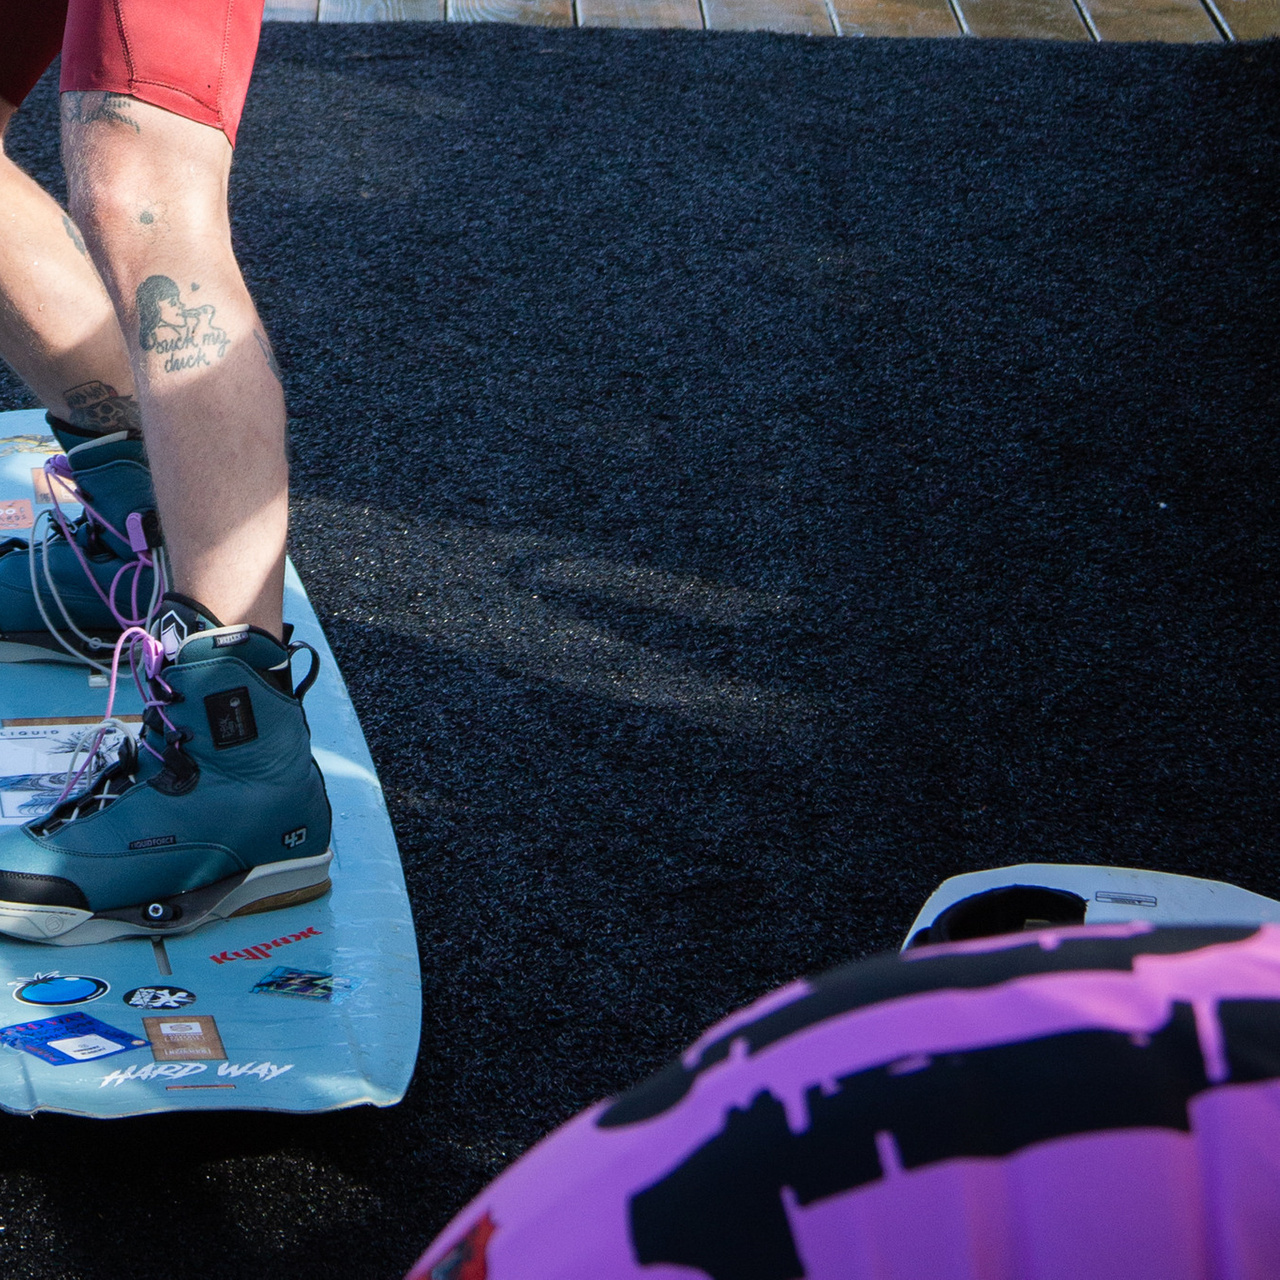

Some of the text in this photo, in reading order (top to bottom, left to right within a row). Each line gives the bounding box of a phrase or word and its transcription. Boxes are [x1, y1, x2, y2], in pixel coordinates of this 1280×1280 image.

[164, 348, 210, 373] duck
[99, 1061, 295, 1089] HARD WAY
